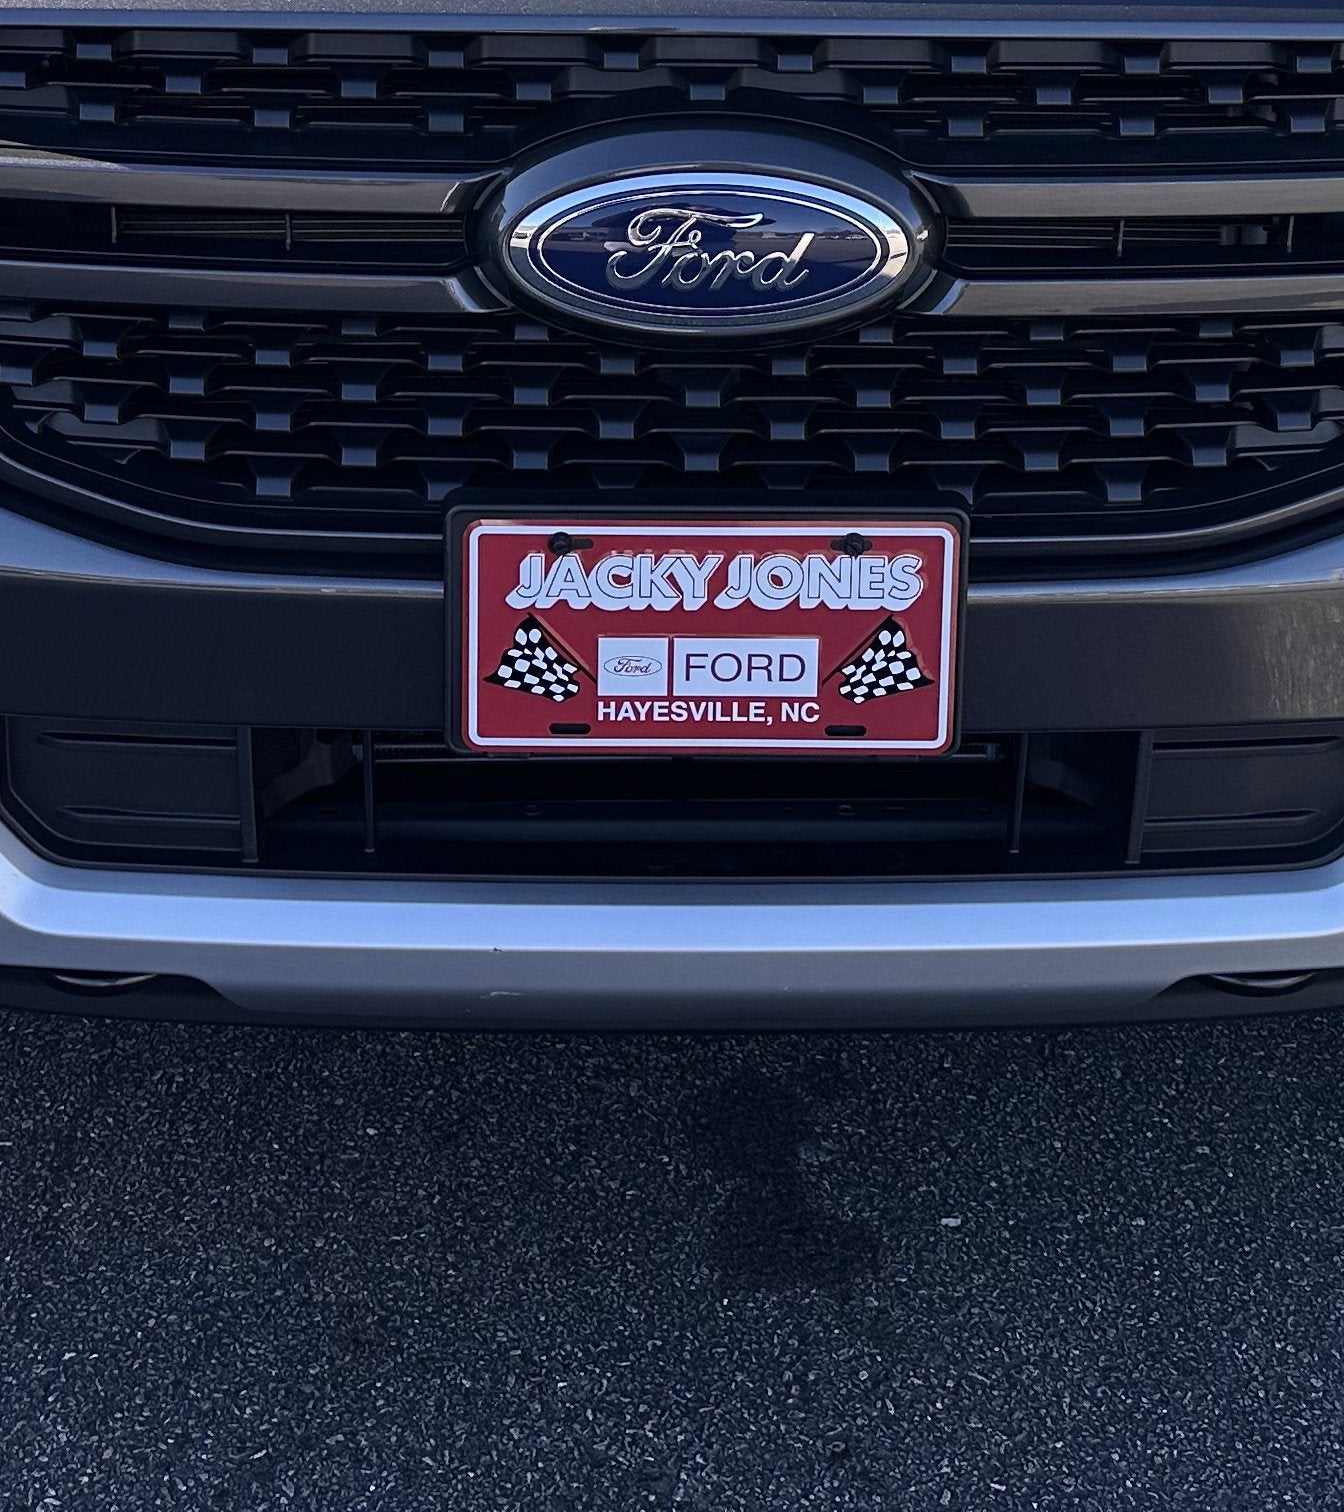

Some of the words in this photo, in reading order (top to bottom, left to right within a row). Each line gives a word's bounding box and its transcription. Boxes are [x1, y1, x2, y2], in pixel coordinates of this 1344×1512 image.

[605, 207, 815, 289] Ford
[506, 553, 722, 610] JACKY
[713, 553, 925, 610] JONES
[612, 655, 654, 677] Ford
[684, 653, 807, 683] FORD
[597, 701, 774, 726] HAYESVILLE,
[781, 701, 821, 724] NC
